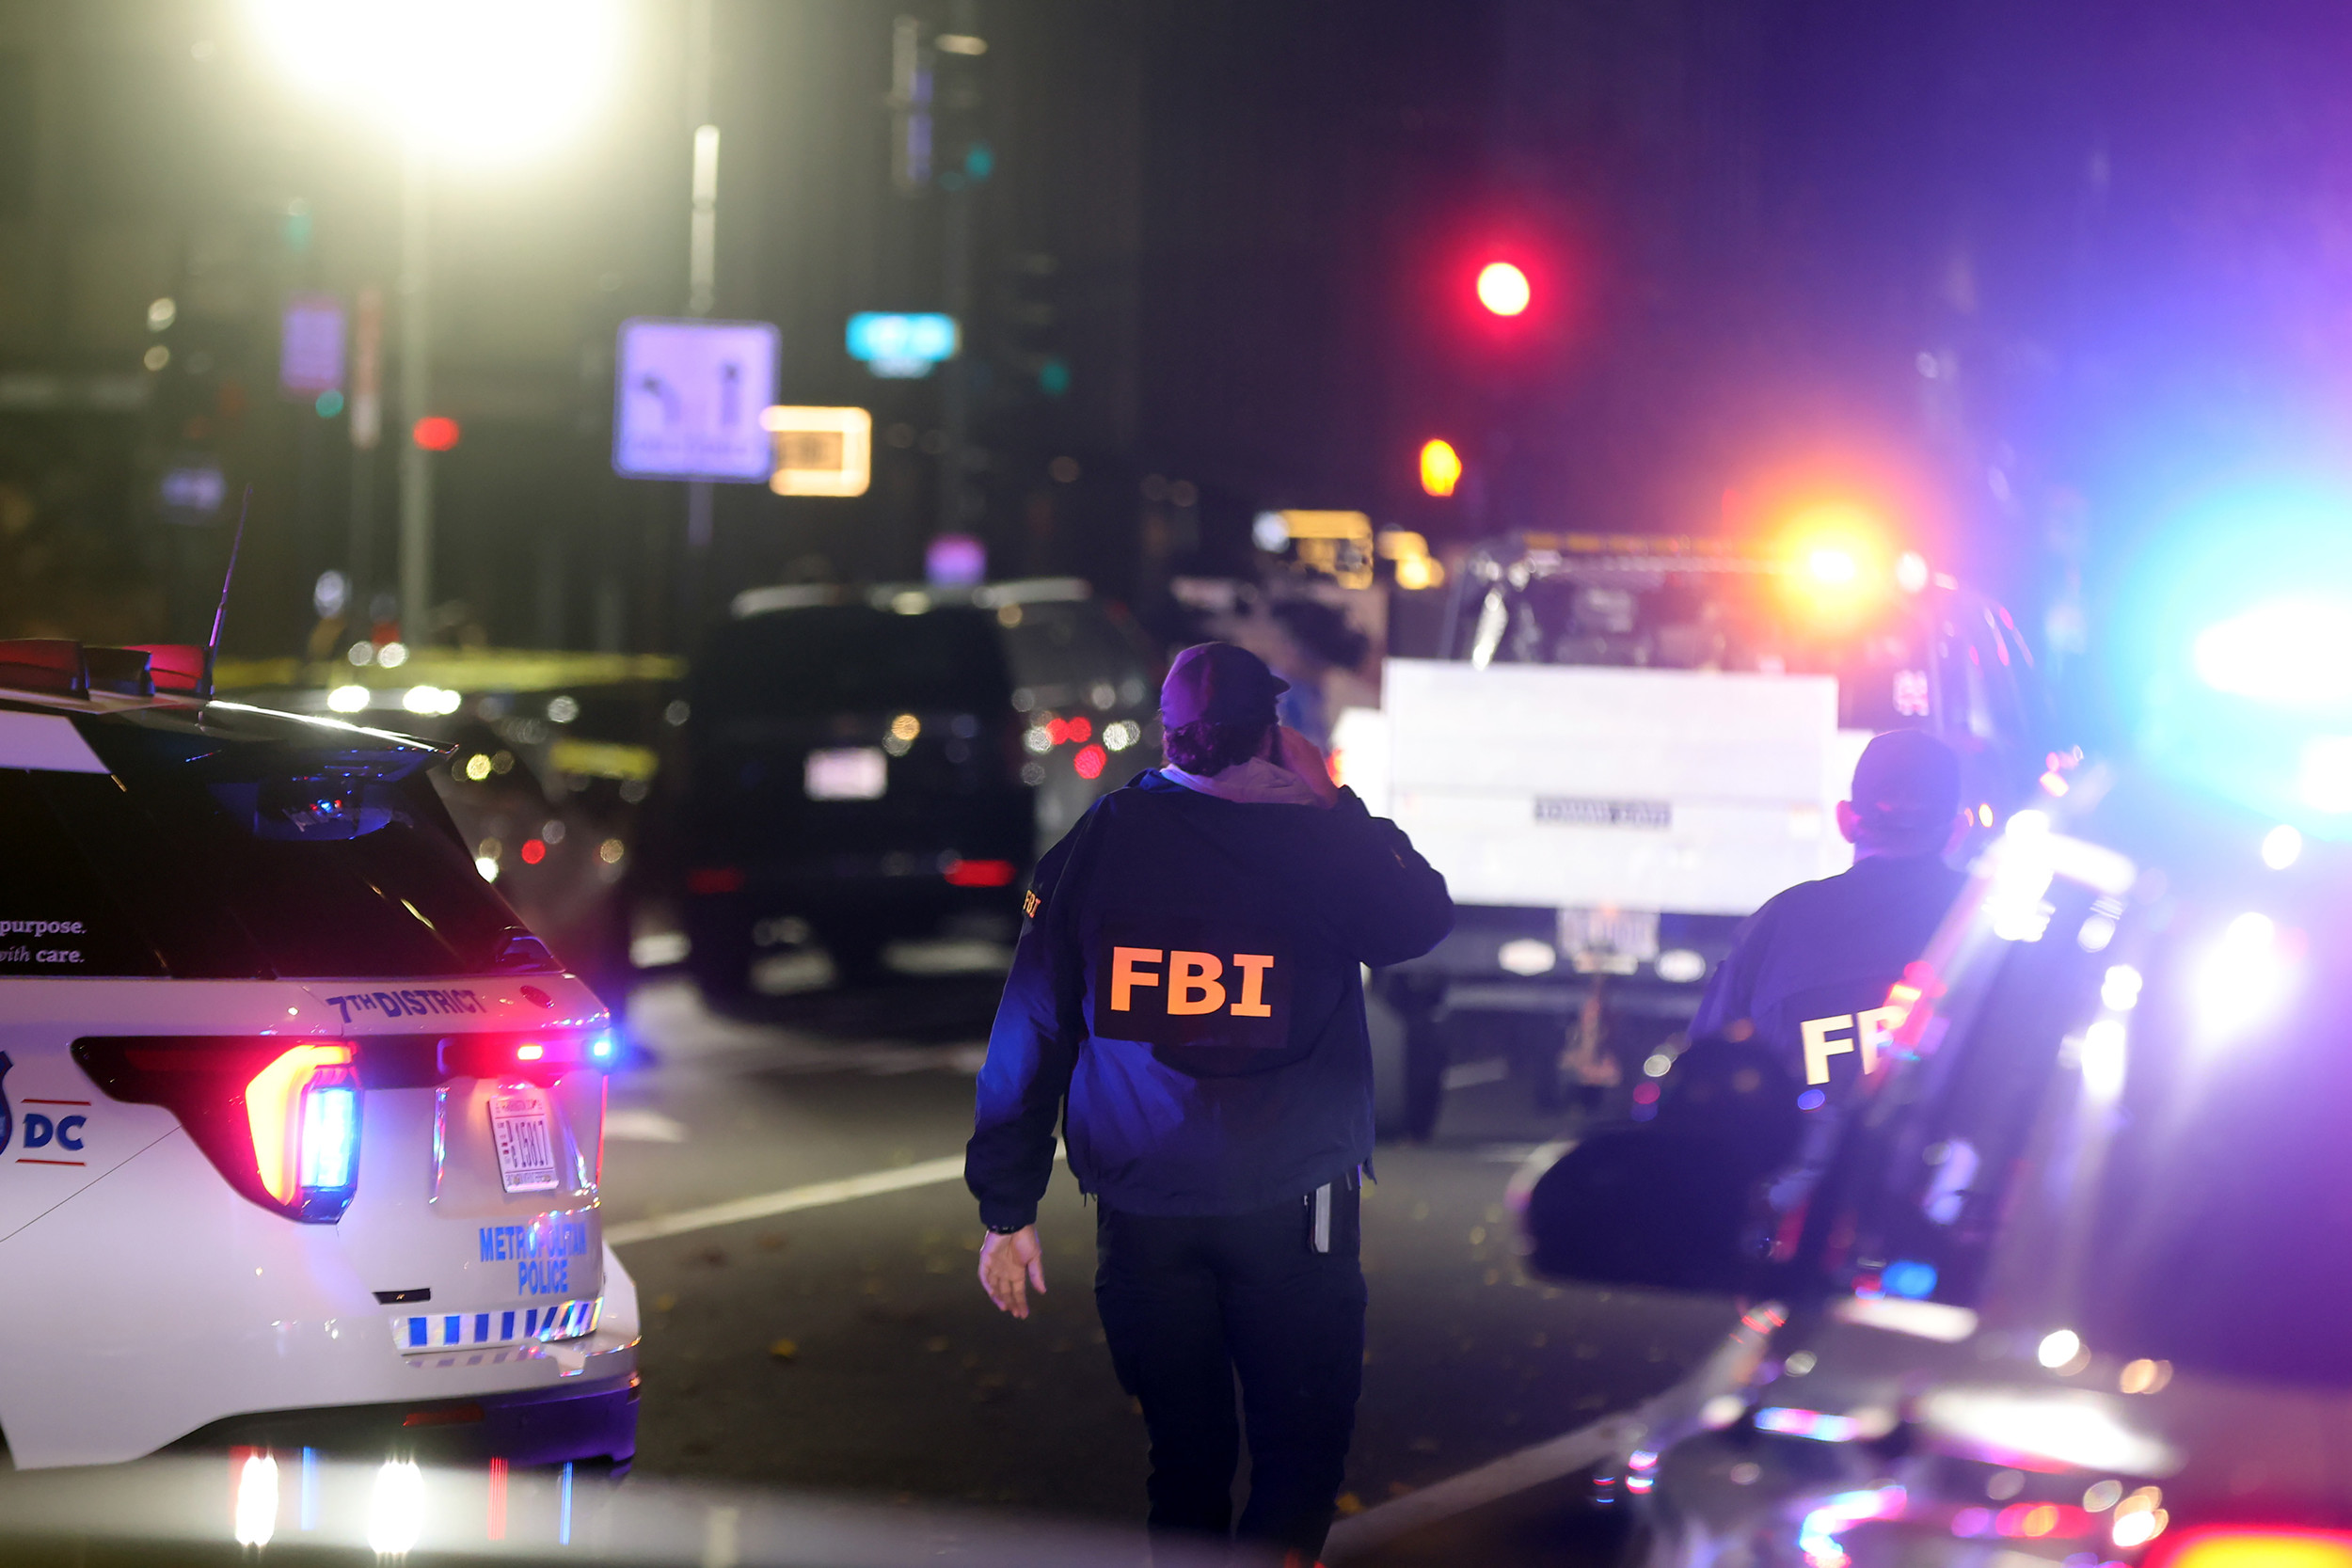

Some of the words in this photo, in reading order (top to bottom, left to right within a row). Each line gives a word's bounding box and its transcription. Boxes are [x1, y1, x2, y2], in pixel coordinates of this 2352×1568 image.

[1023, 889, 1041, 919] FBI
[0, 920, 87, 938] purpose.
[36, 949, 86, 963] care.
[1110, 946, 1275, 1018] FBI
[326, 993, 377, 1024] 7TH
[372, 990, 487, 1018] DISTRICT
[23, 1113, 88, 1151] DC
[517, 1259, 568, 1296] POLICE
